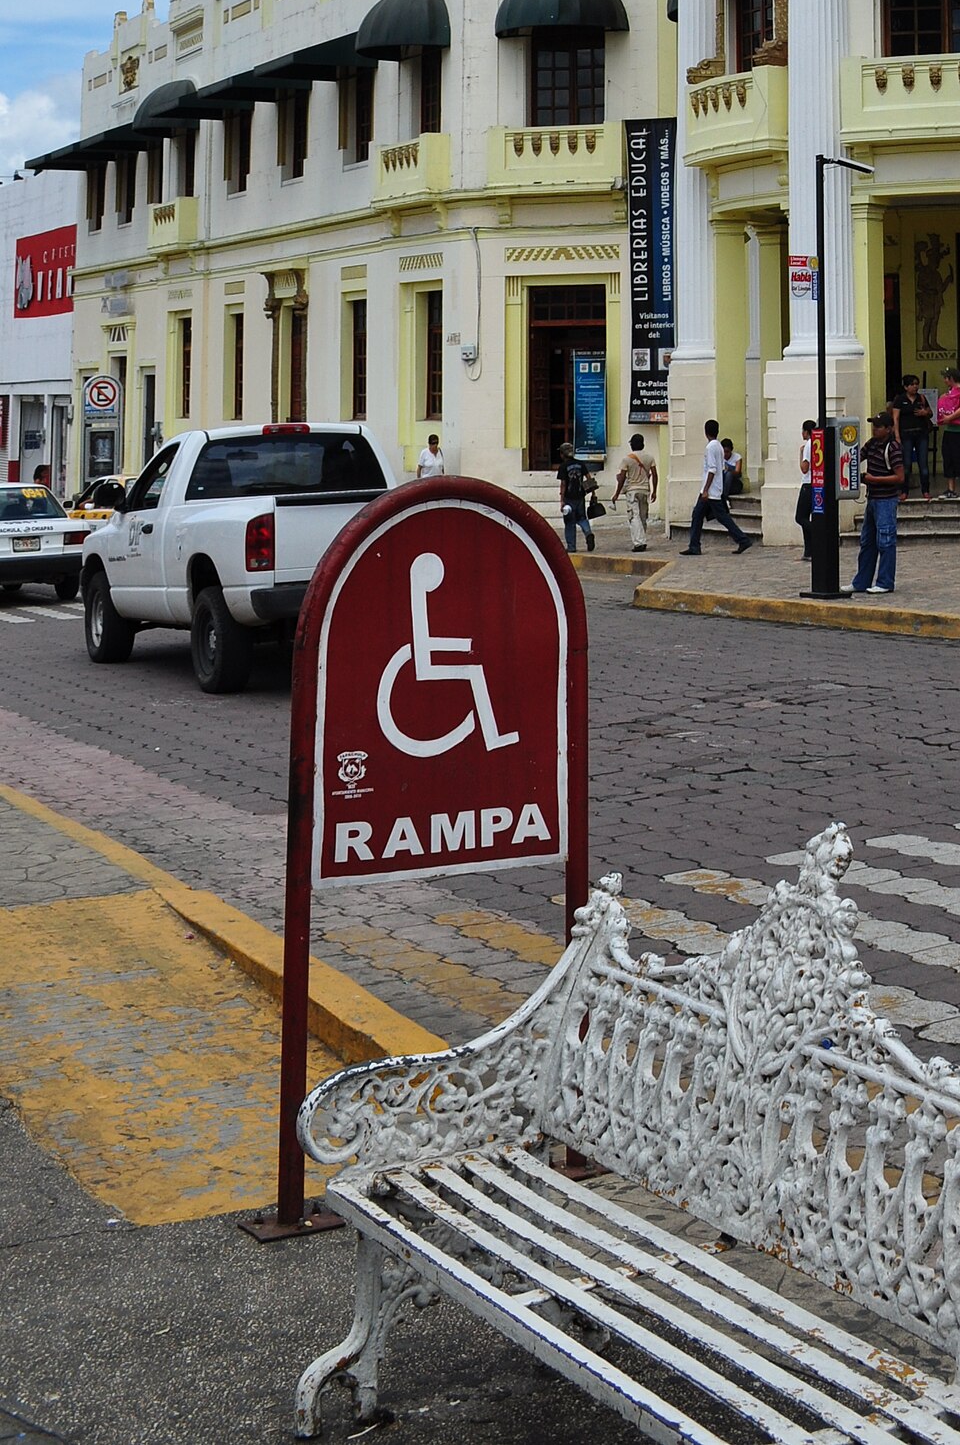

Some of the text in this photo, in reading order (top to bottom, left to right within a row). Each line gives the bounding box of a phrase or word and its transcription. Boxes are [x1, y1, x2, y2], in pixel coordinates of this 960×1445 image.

[630, 127, 648, 198] EDUCAL
[660, 161, 670, 169] Y
[660, 171, 670, 209] VIDEOS
[659, 216, 671, 256] MÚSICA
[662, 264, 671, 302] LIBROS
[791, 271, 812, 282] Habla
[650, 321, 674, 329] interior
[812, 438, 824, 467] 3
[850, 445, 858, 490] MONEDAS
[21, 488, 48, 499] 0947
[334, 803, 552, 863] RAMPA
